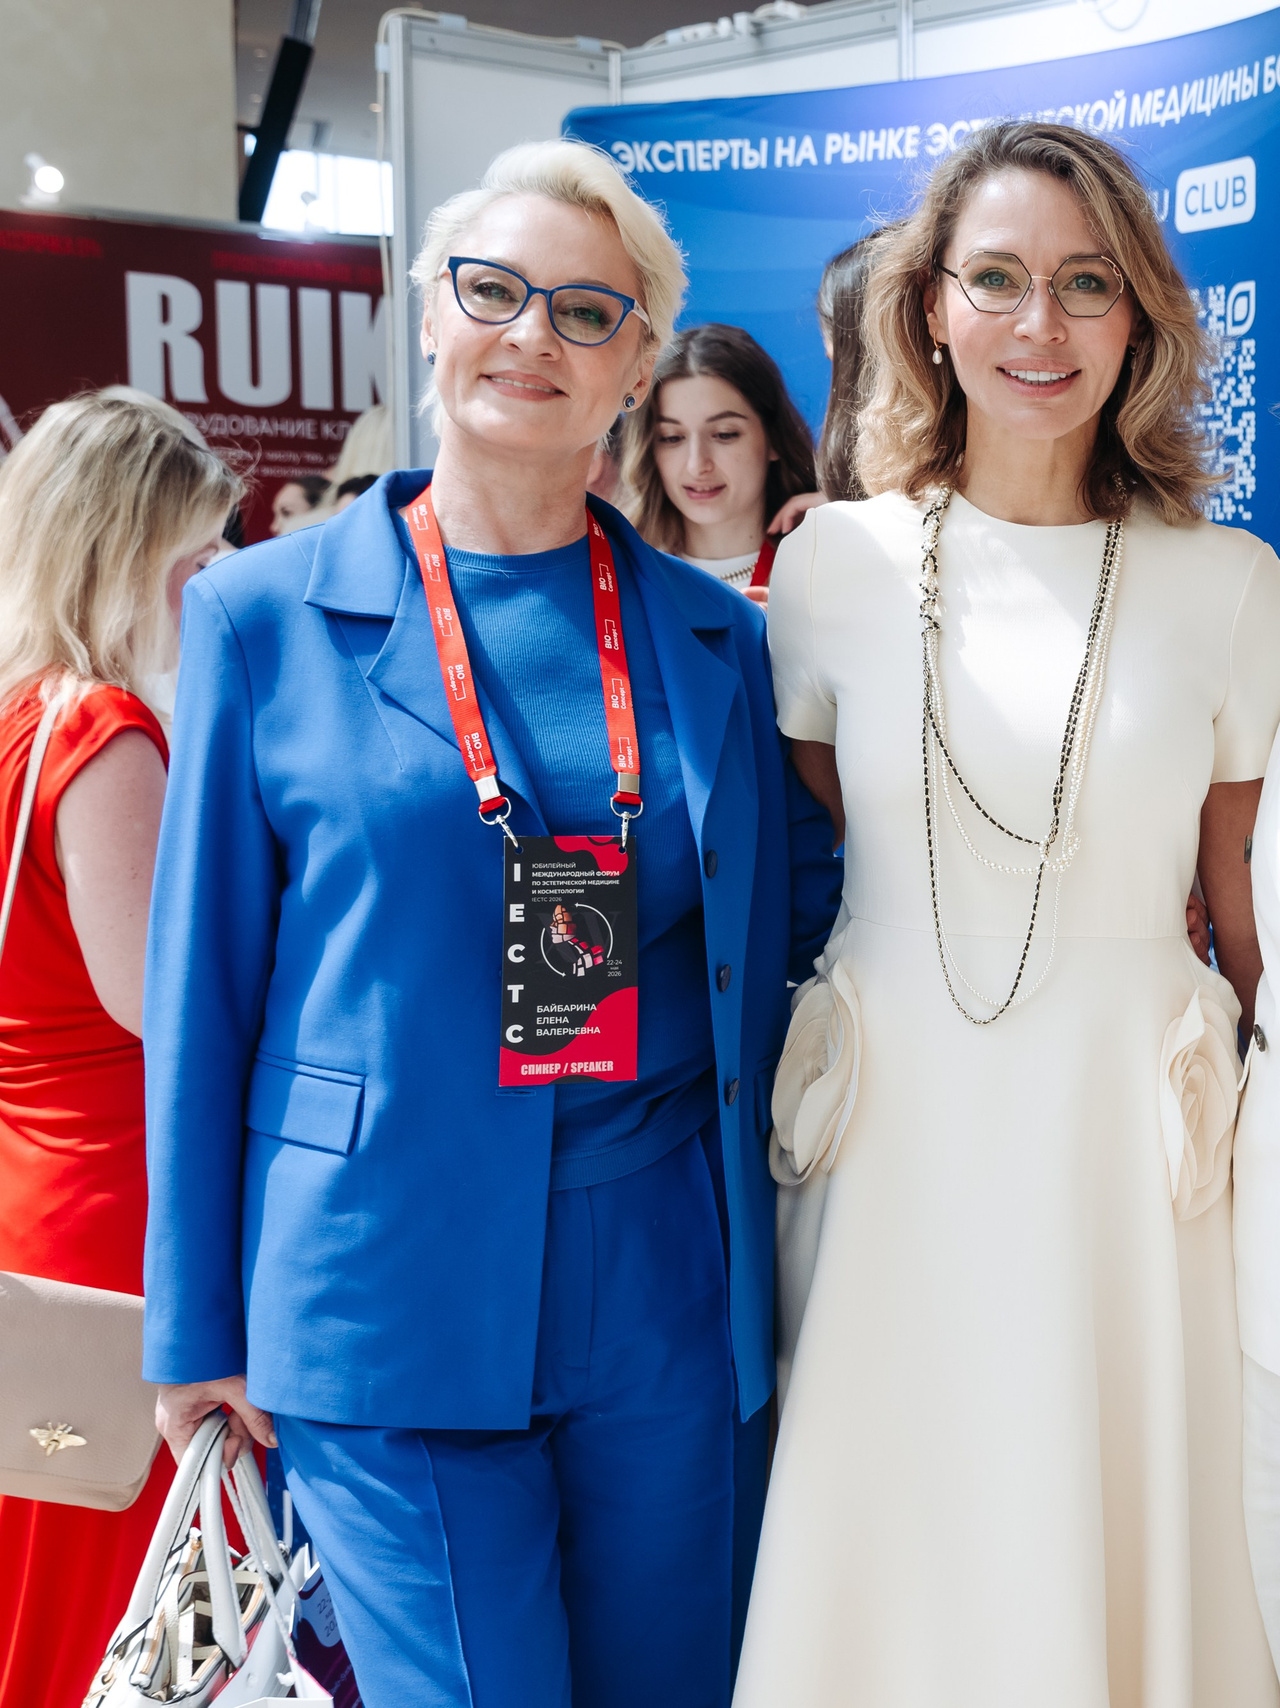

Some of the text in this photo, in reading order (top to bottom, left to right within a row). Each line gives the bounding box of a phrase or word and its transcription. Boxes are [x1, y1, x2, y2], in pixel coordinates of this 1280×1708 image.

[611, 136, 767, 174] ЭКСПЕРТЫ
[775, 135, 818, 168] НА
[825, 127, 919, 165] РЫНКЕ
[1129, 61, 1260, 128] МЕДИЦИНЫ
[1185, 176, 1247, 215] CLUB
[443, 608, 453, 621] BIO
[604, 634, 612, 649] BIO
[447, 665, 458, 692] Concept
[455, 664, 465, 680] BIO
[611, 694, 620, 709] BIO
[464, 735, 476, 762] Concept
[471, 732, 482, 750] BIO
[617, 754, 627, 768] BIO
[531, 870, 595, 878] МЕЖДУНАРОДНЫЙ
[536, 1003, 597, 1013] БАЙБАРИНА
[536, 1016, 569, 1025] ЕЛЕНА
[536, 1026, 601, 1037] ВАЛЕРЬЕВНА
[520, 1063, 561, 1076] СПИКЕР
[570, 1060, 614, 1073] SPEAKER
